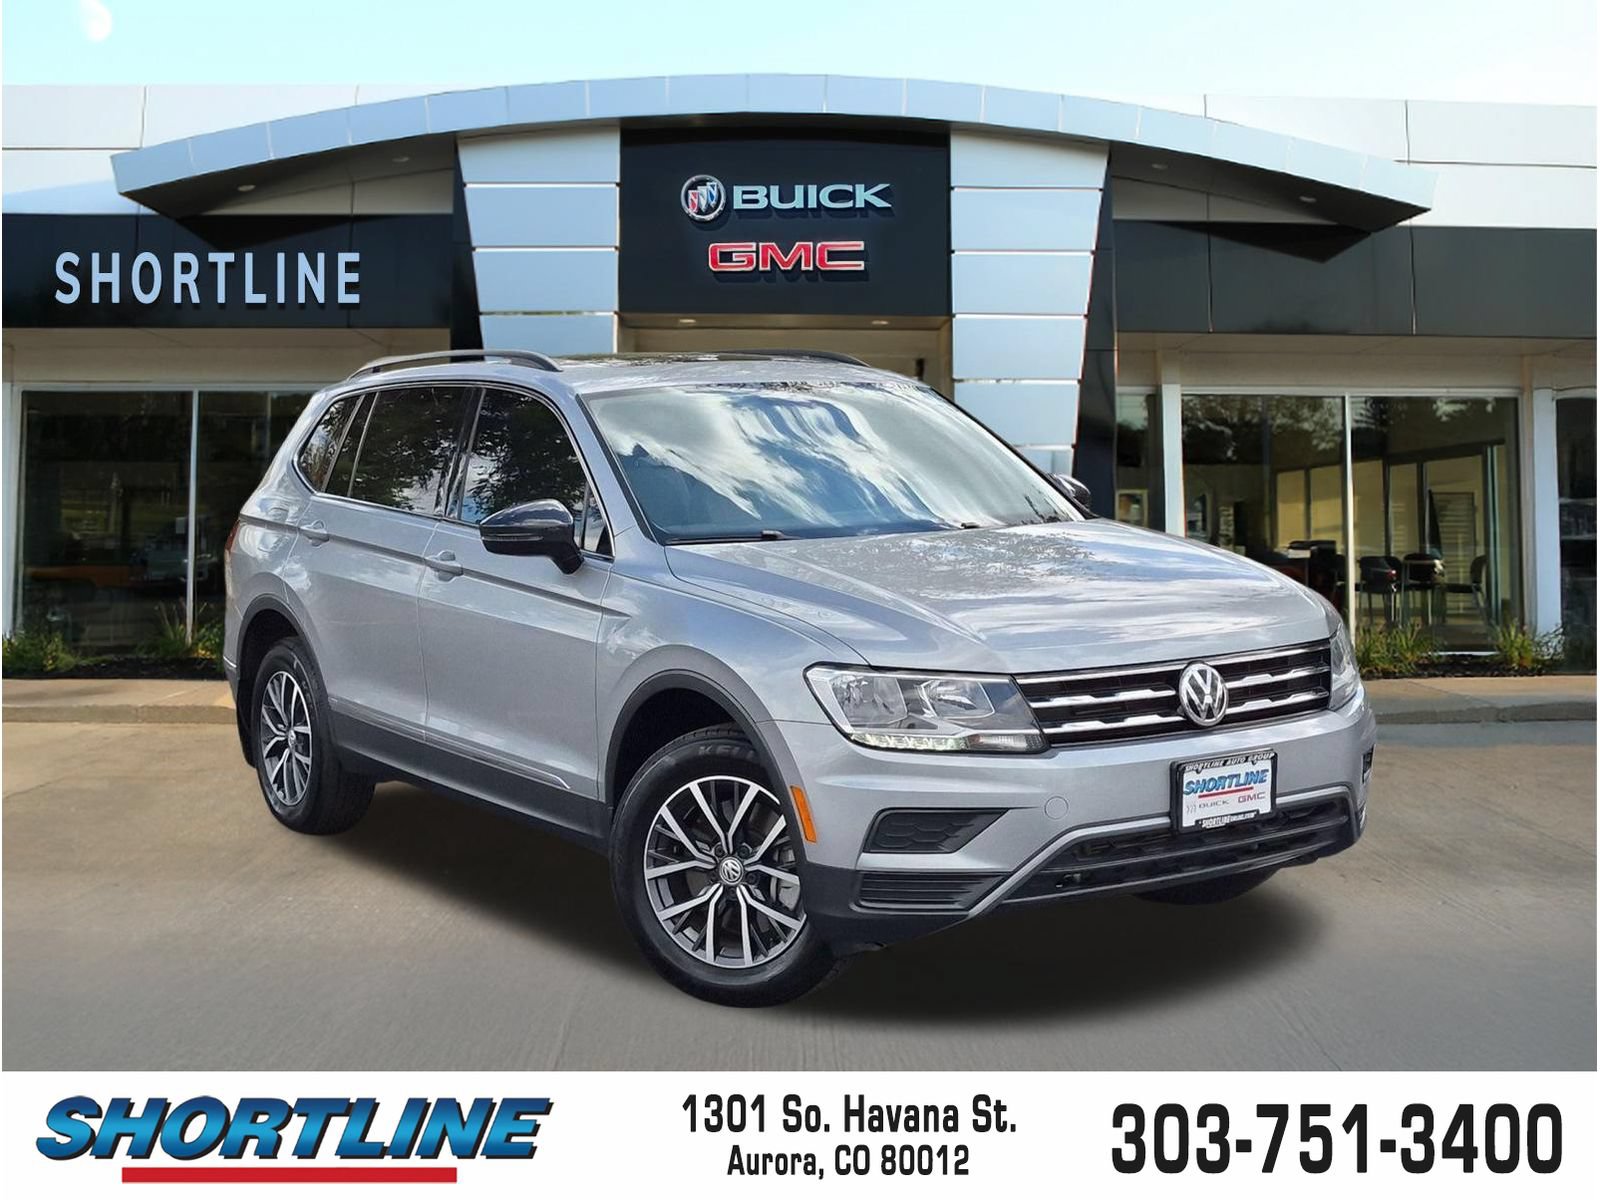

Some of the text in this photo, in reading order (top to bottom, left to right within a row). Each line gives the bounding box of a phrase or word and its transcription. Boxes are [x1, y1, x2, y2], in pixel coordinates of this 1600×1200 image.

[733, 183, 892, 210] BUICK
[708, 240, 865, 272] GMC
[54, 251, 361, 305] SHORTLINE
[1185, 752, 1275, 771] SHORTLINE AUTO GROUP
[1183, 769, 1269, 795] SHORTLINE
[1199, 792, 1265, 809] BUICK GMC
